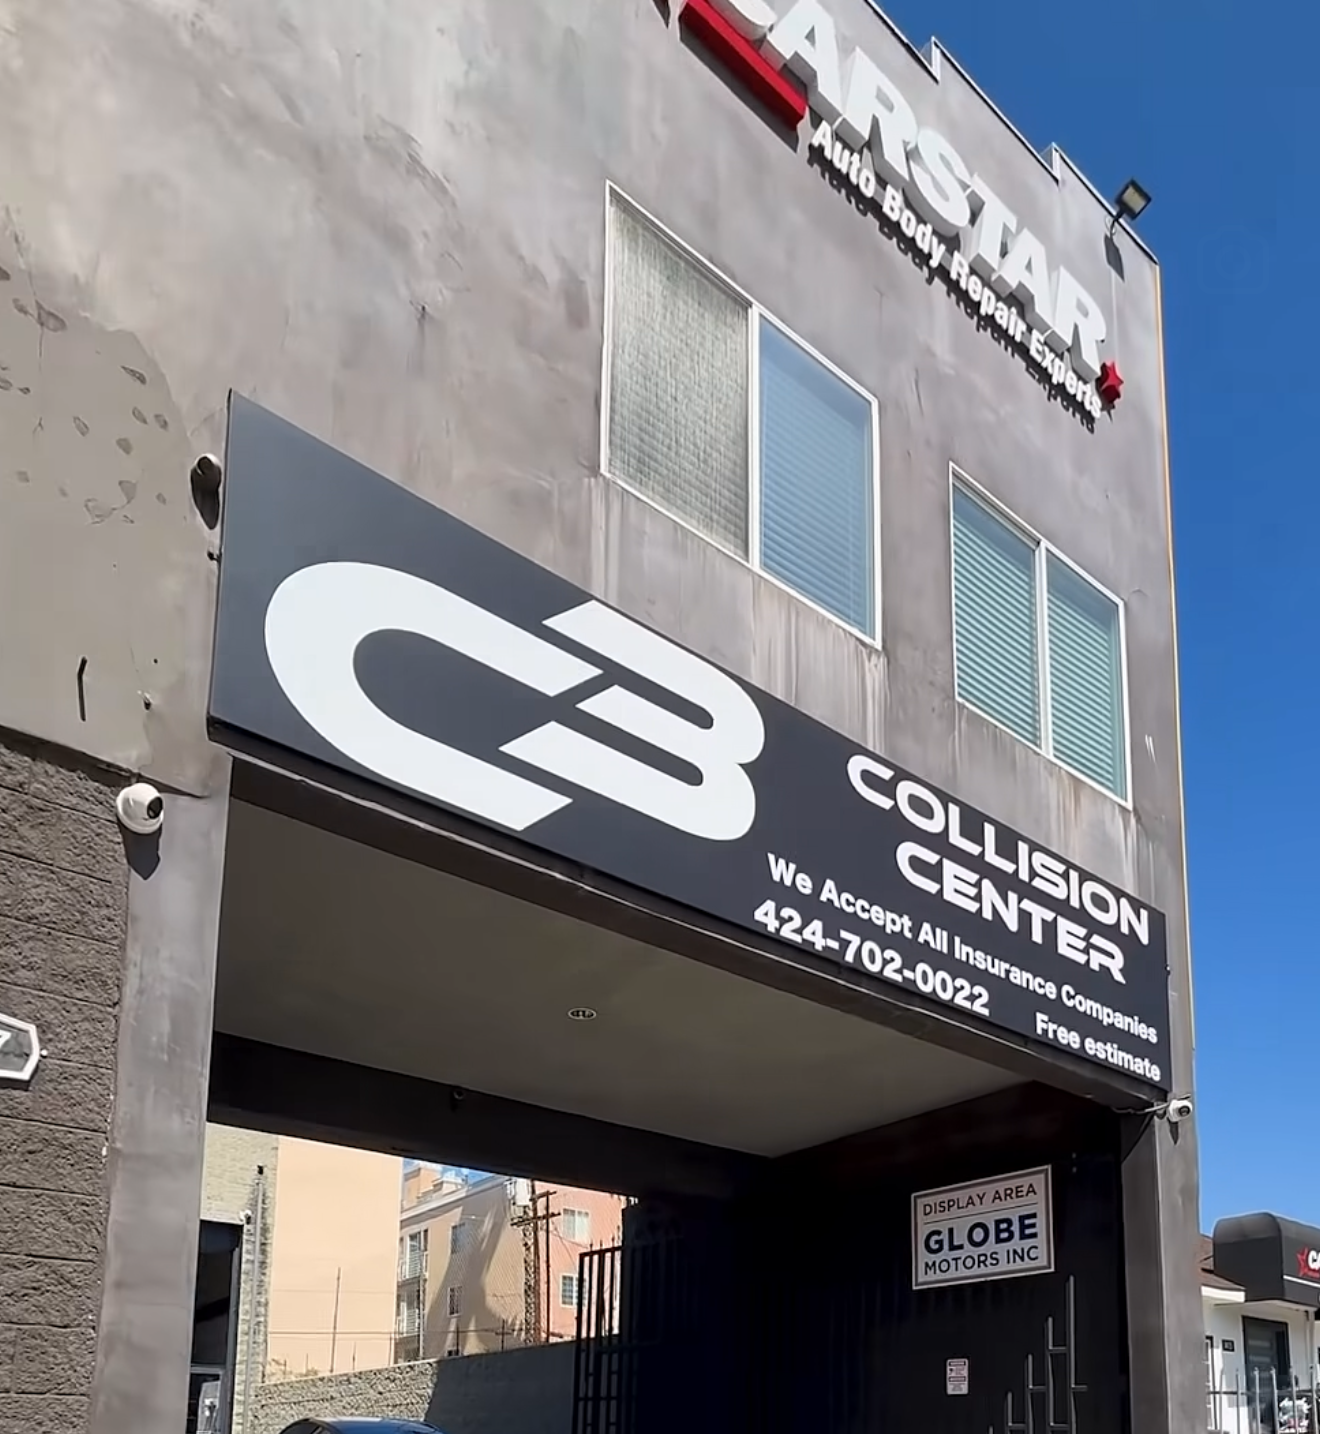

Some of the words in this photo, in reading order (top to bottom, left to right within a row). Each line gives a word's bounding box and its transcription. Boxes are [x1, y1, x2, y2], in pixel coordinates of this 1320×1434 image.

[810, 119, 877, 199] Auto
[881, 185, 948, 268] Body
[950, 253, 1027, 343] Repair
[1030, 331, 1103, 419] Experts
[846, 754, 1150, 946] COLLISION
[753, 899, 990, 1017] 424-702-0022
[767, 852, 812, 896] We
[819, 878, 913, 940] Accept
[917, 922, 948, 954] All
[954, 936, 1057, 1001] Insurance
[1060, 983, 1158, 1045] Companies
[895, 841, 1126, 984] CENTER
[1036, 1012, 1081, 1050] Free
[1084, 1035, 1161, 1082] estimate
[923, 1192, 987, 1216] DISPLAY
[992, 1183, 1037, 1204] AREA
[924, 1212, 1038, 1255] GLOBE
[924, 1251, 1000, 1275] MOTORS
[1006, 1245, 1039, 1264] INC
